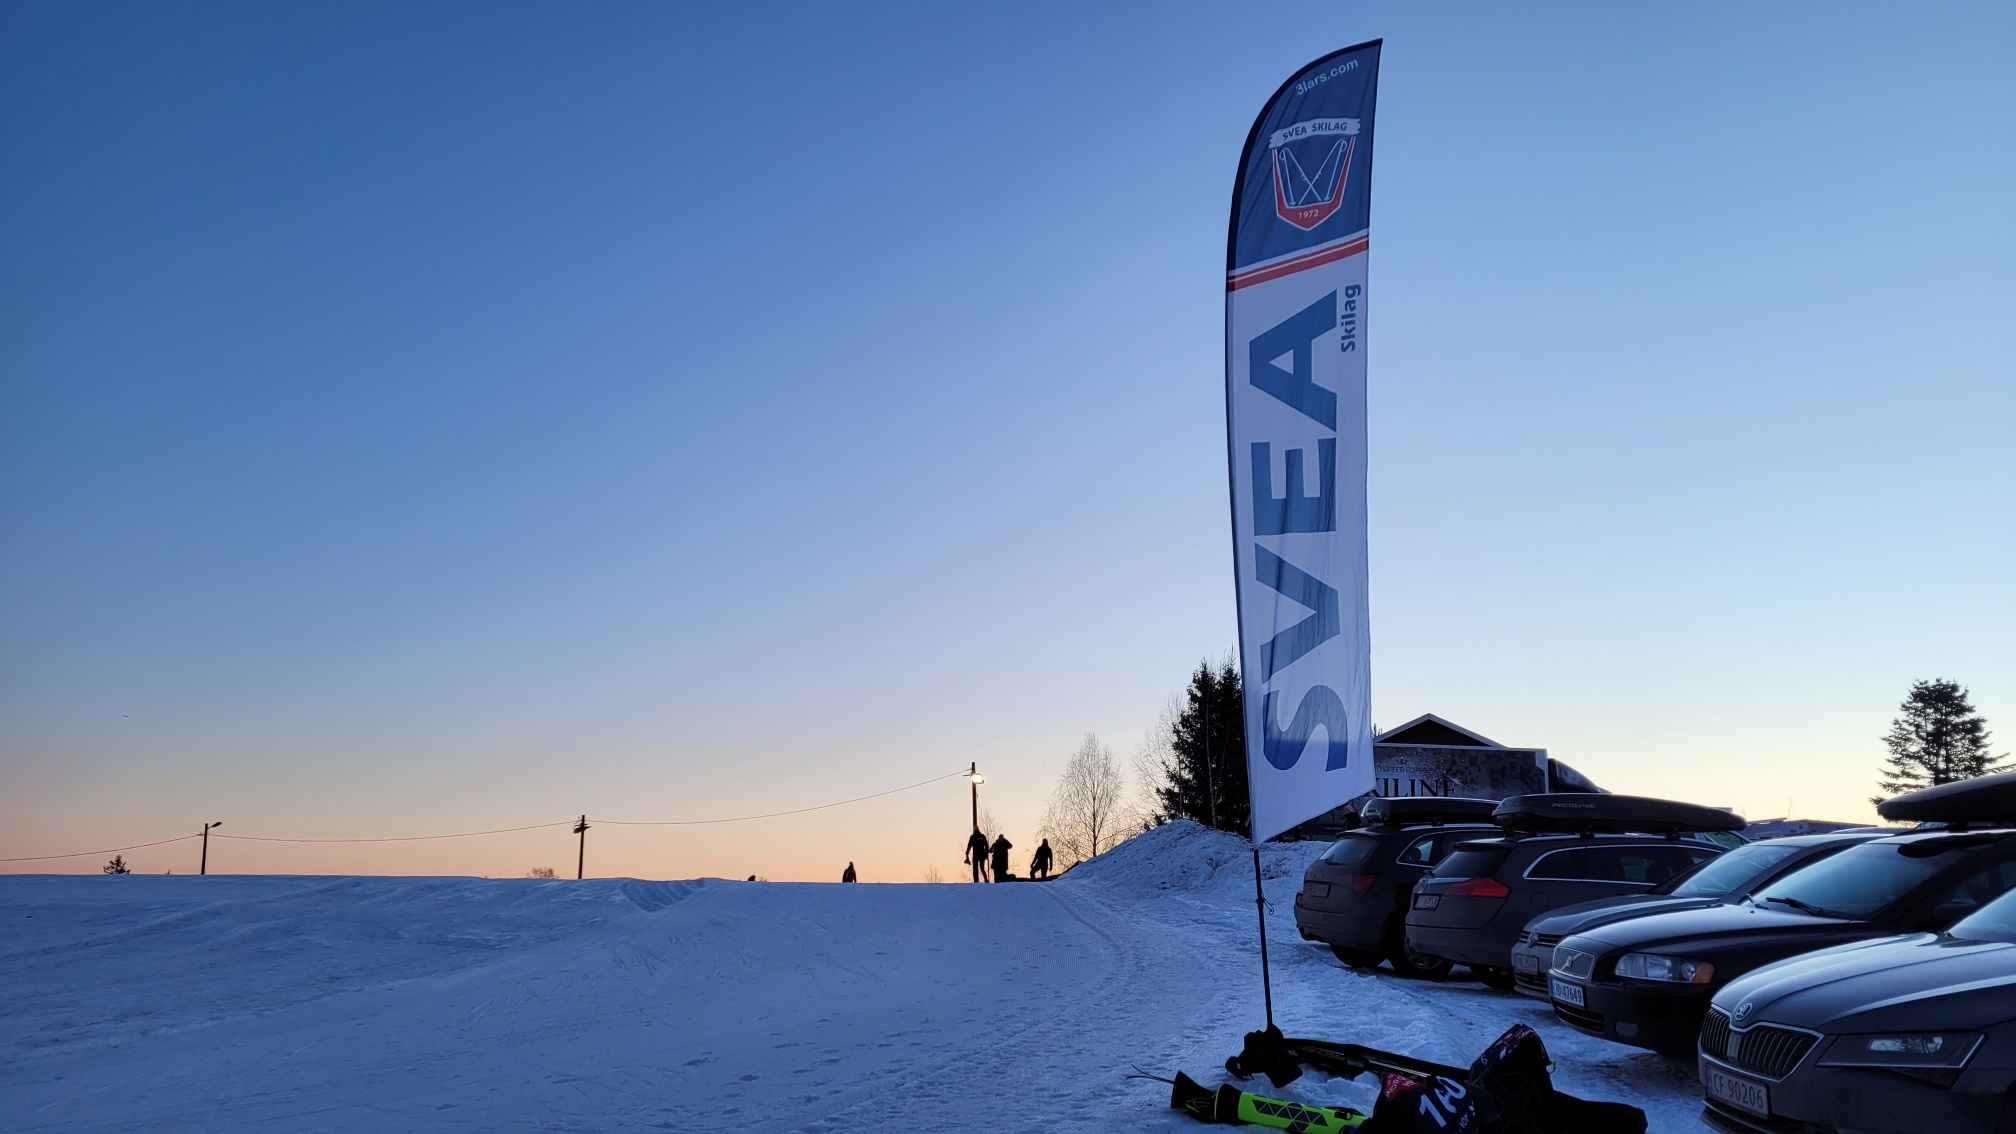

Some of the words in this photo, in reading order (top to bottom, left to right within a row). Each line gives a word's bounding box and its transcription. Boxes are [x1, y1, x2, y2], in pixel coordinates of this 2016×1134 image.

[1295, 59, 1359, 95] 3lars.com
[1282, 125, 1308, 141] SVEA
[1312, 122, 1348, 132] SKILAG
[1298, 209, 1319, 219] 1972
[1340, 283, 1361, 353] Skilag
[1249, 288, 1348, 772] SVEA
[1713, 1073, 1724, 1095] CF
[1728, 1078, 1764, 1109] 90206
